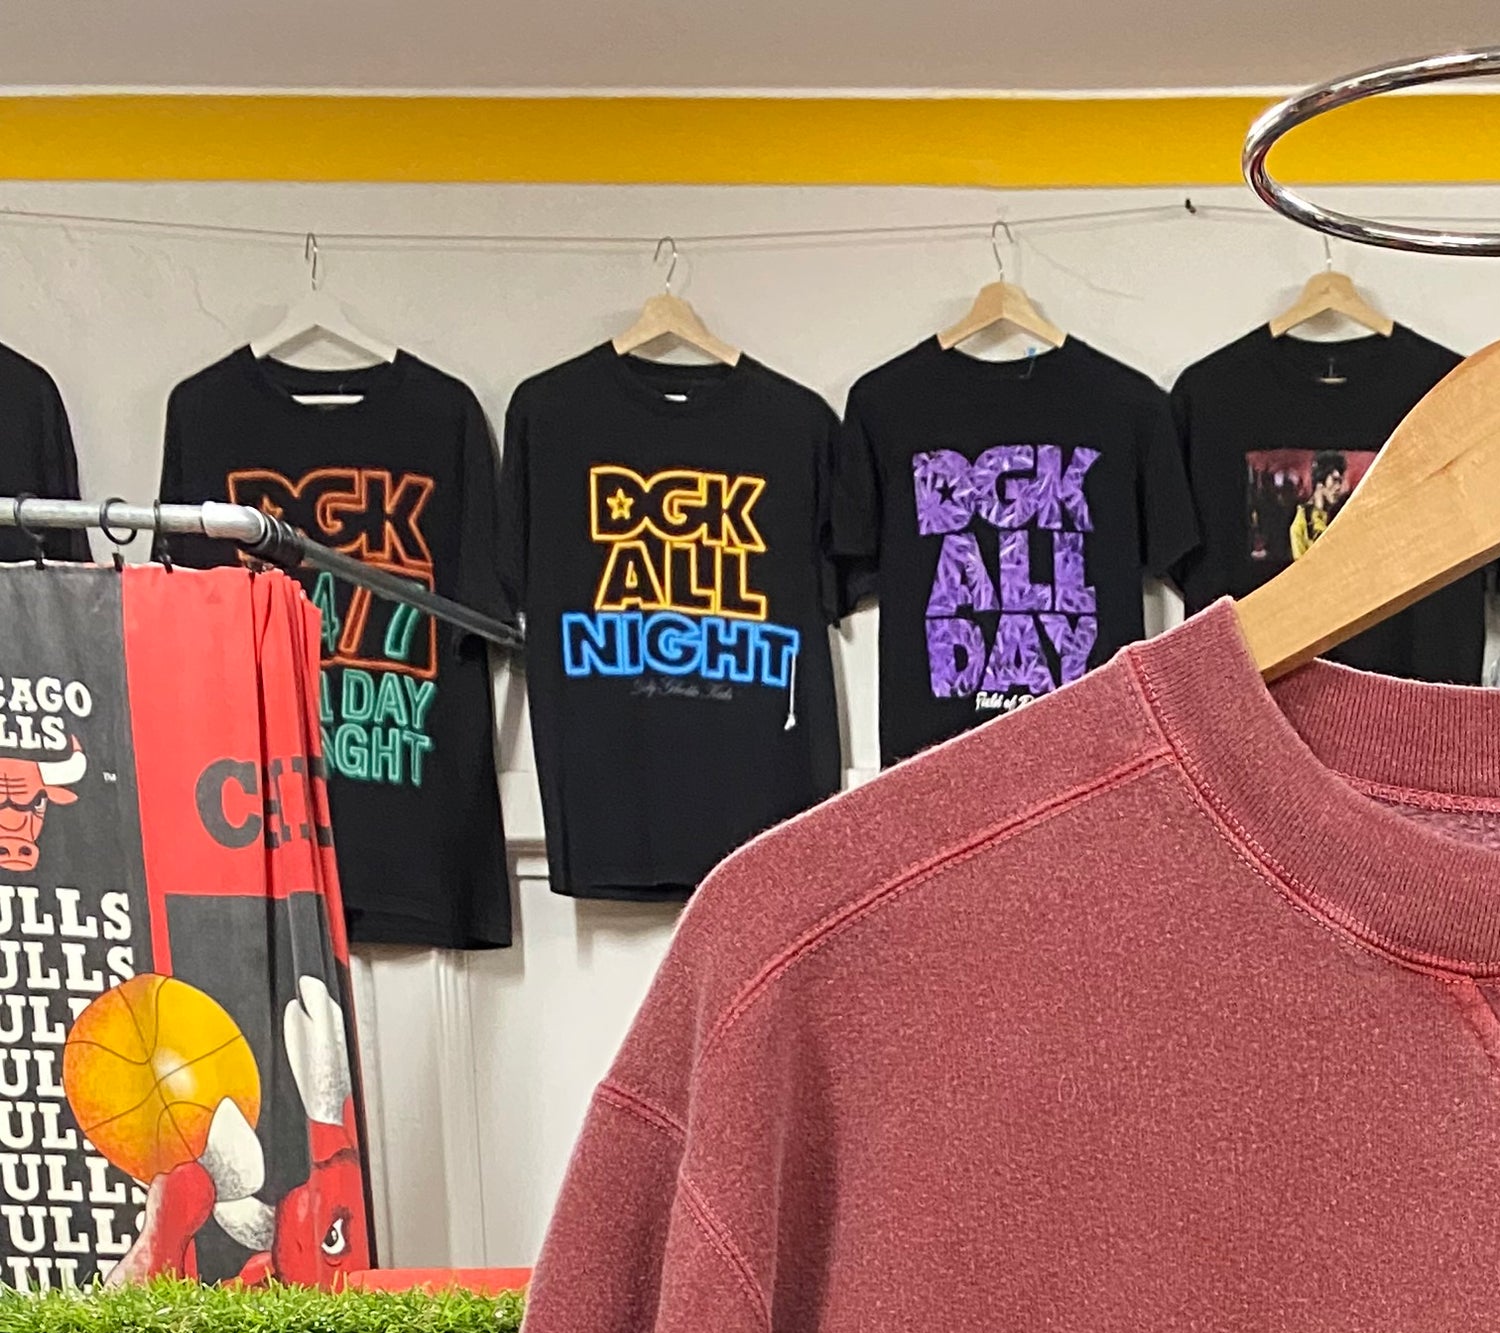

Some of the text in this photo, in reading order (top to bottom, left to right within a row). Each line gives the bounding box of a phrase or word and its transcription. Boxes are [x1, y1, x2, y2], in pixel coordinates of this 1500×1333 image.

[590, 466, 766, 553] DGK
[912, 444, 1101, 536] DGK
[594, 540, 766, 620] ALL
[925, 530, 1096, 616] ALL
[562, 612, 799, 687] NIGHT
[925, 613, 1098, 699] DAY
[0, 676, 92, 718] AGO
[342, 668, 437, 730] DAY
[1, 1205, 146, 1253] ULL
